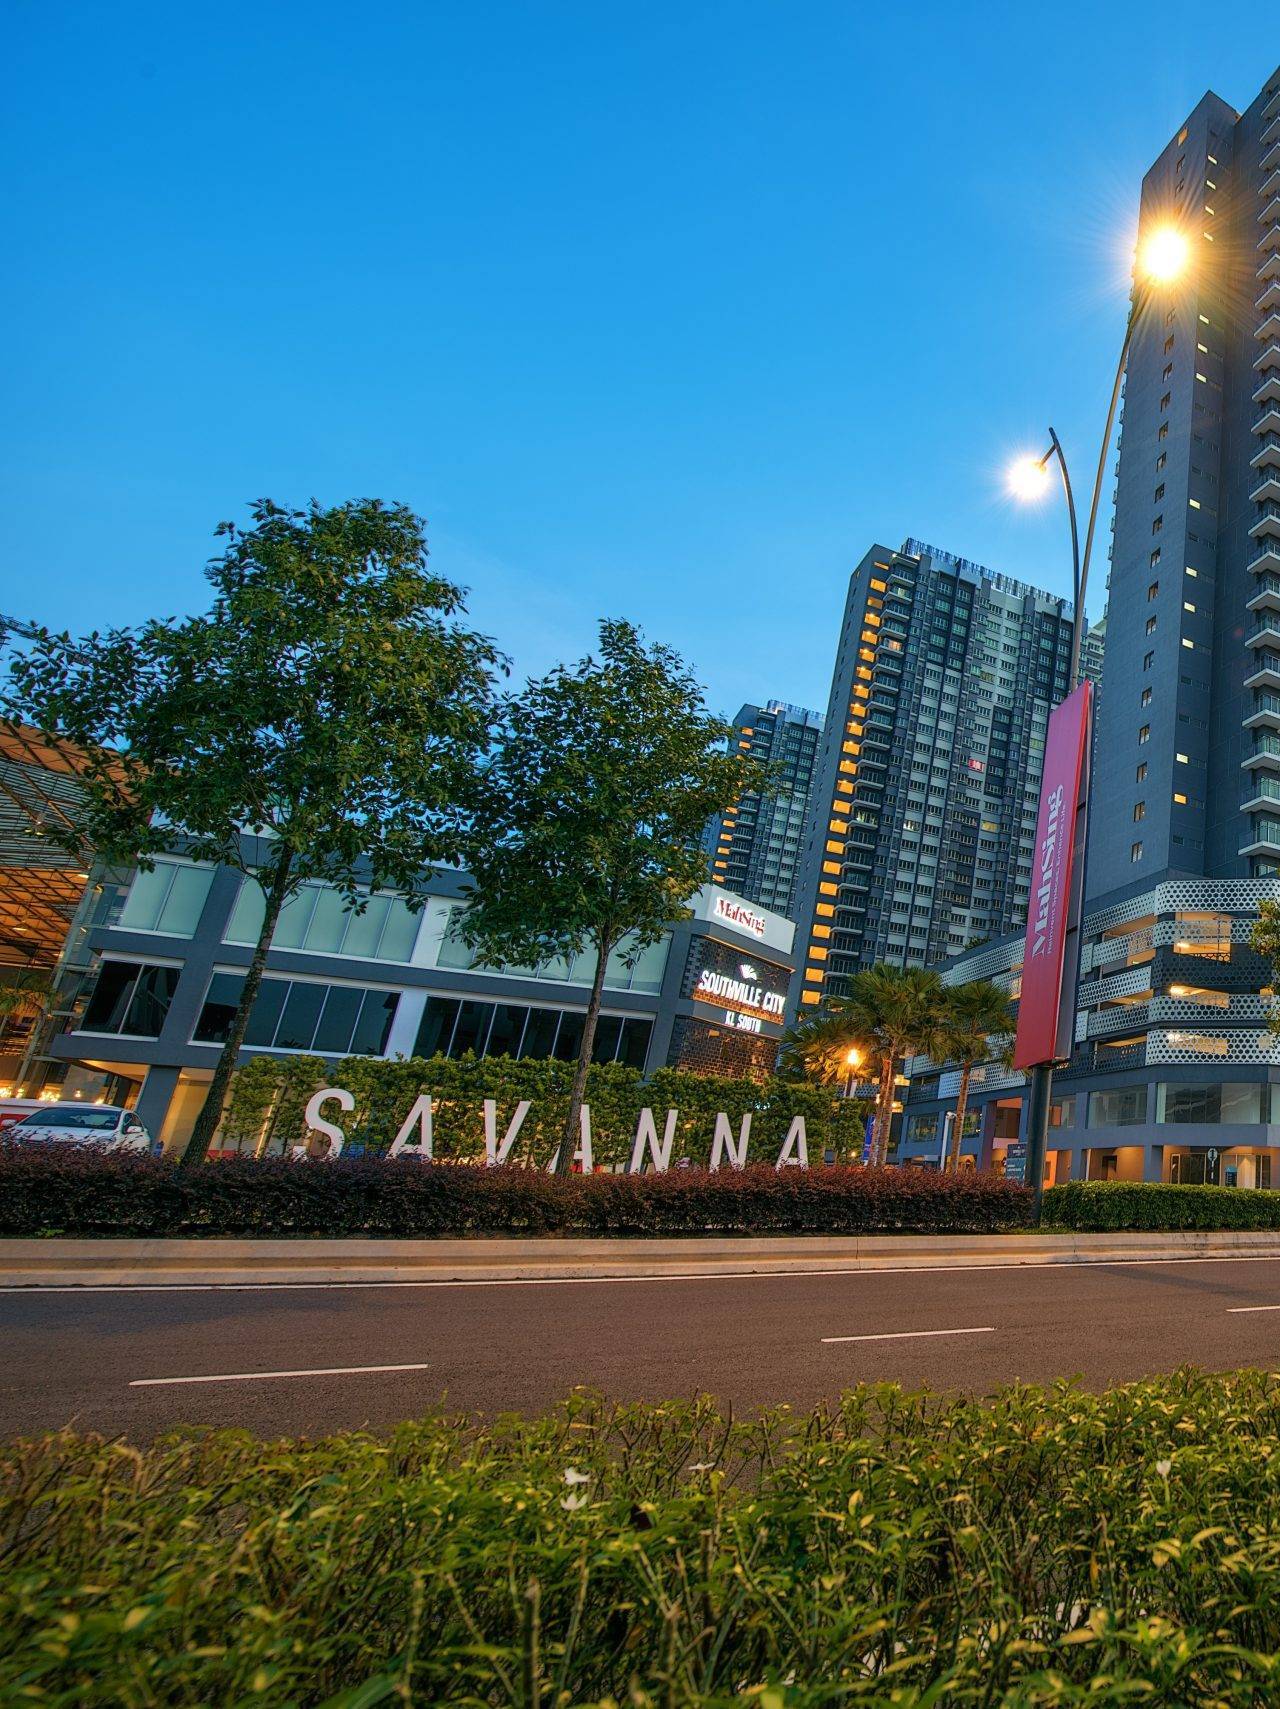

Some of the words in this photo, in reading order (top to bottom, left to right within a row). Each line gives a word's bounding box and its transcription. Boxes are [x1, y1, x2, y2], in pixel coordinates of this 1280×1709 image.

[1032, 784, 1064, 960] MahSing
[715, 898, 766, 936] MahSing
[698, 969, 762, 1008] SOUTHVILLE
[762, 991, 786, 1015] CITY
[725, 1010, 735, 1027] KL
[736, 1014, 762, 1033] SOUTH
[292, 1088, 809, 1175] SAVANNA
